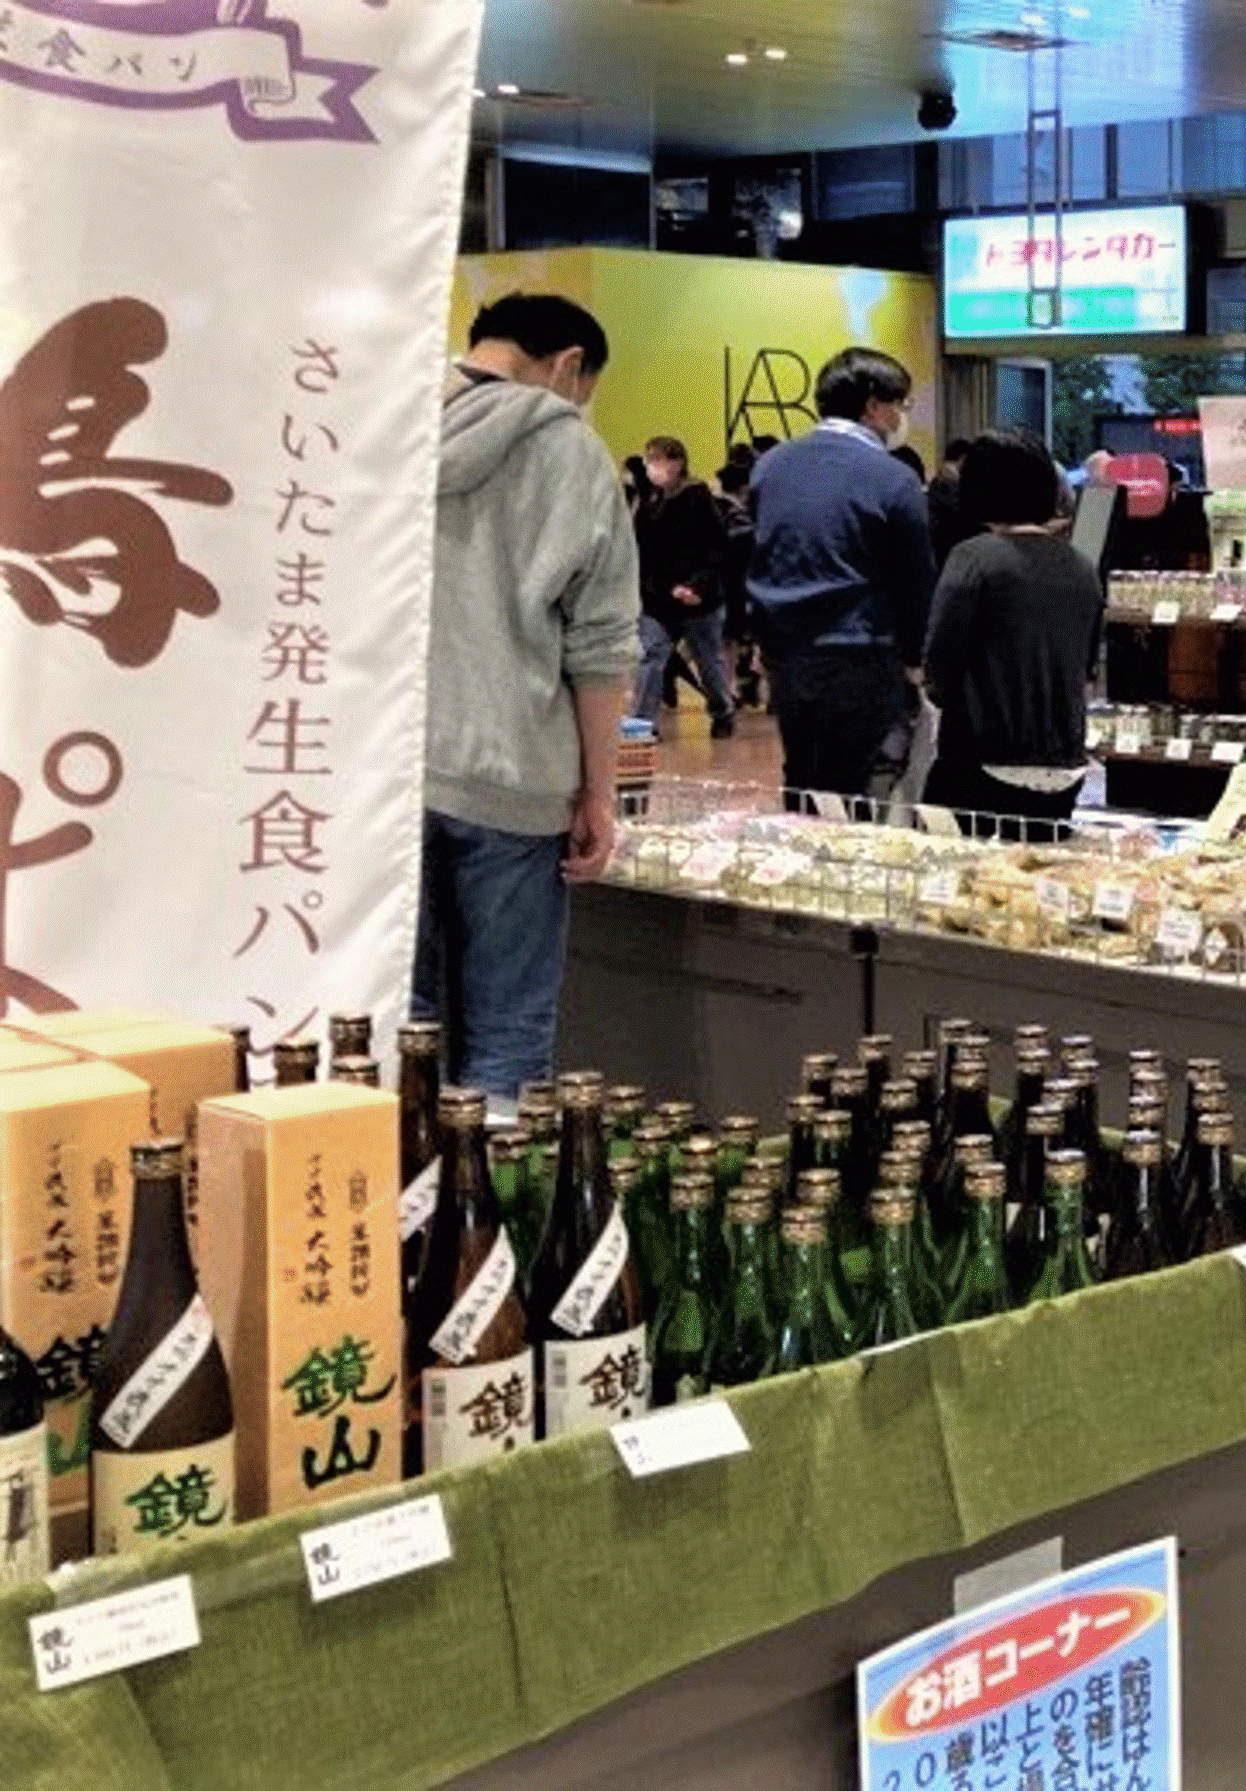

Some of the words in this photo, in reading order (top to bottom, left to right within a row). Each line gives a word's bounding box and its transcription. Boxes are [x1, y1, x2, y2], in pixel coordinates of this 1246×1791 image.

[280, 1334, 397, 1489] 鏡山
[125, 1462, 227, 1540] 鏡
[905, 1609, 1132, 1727] お酒コーナー
